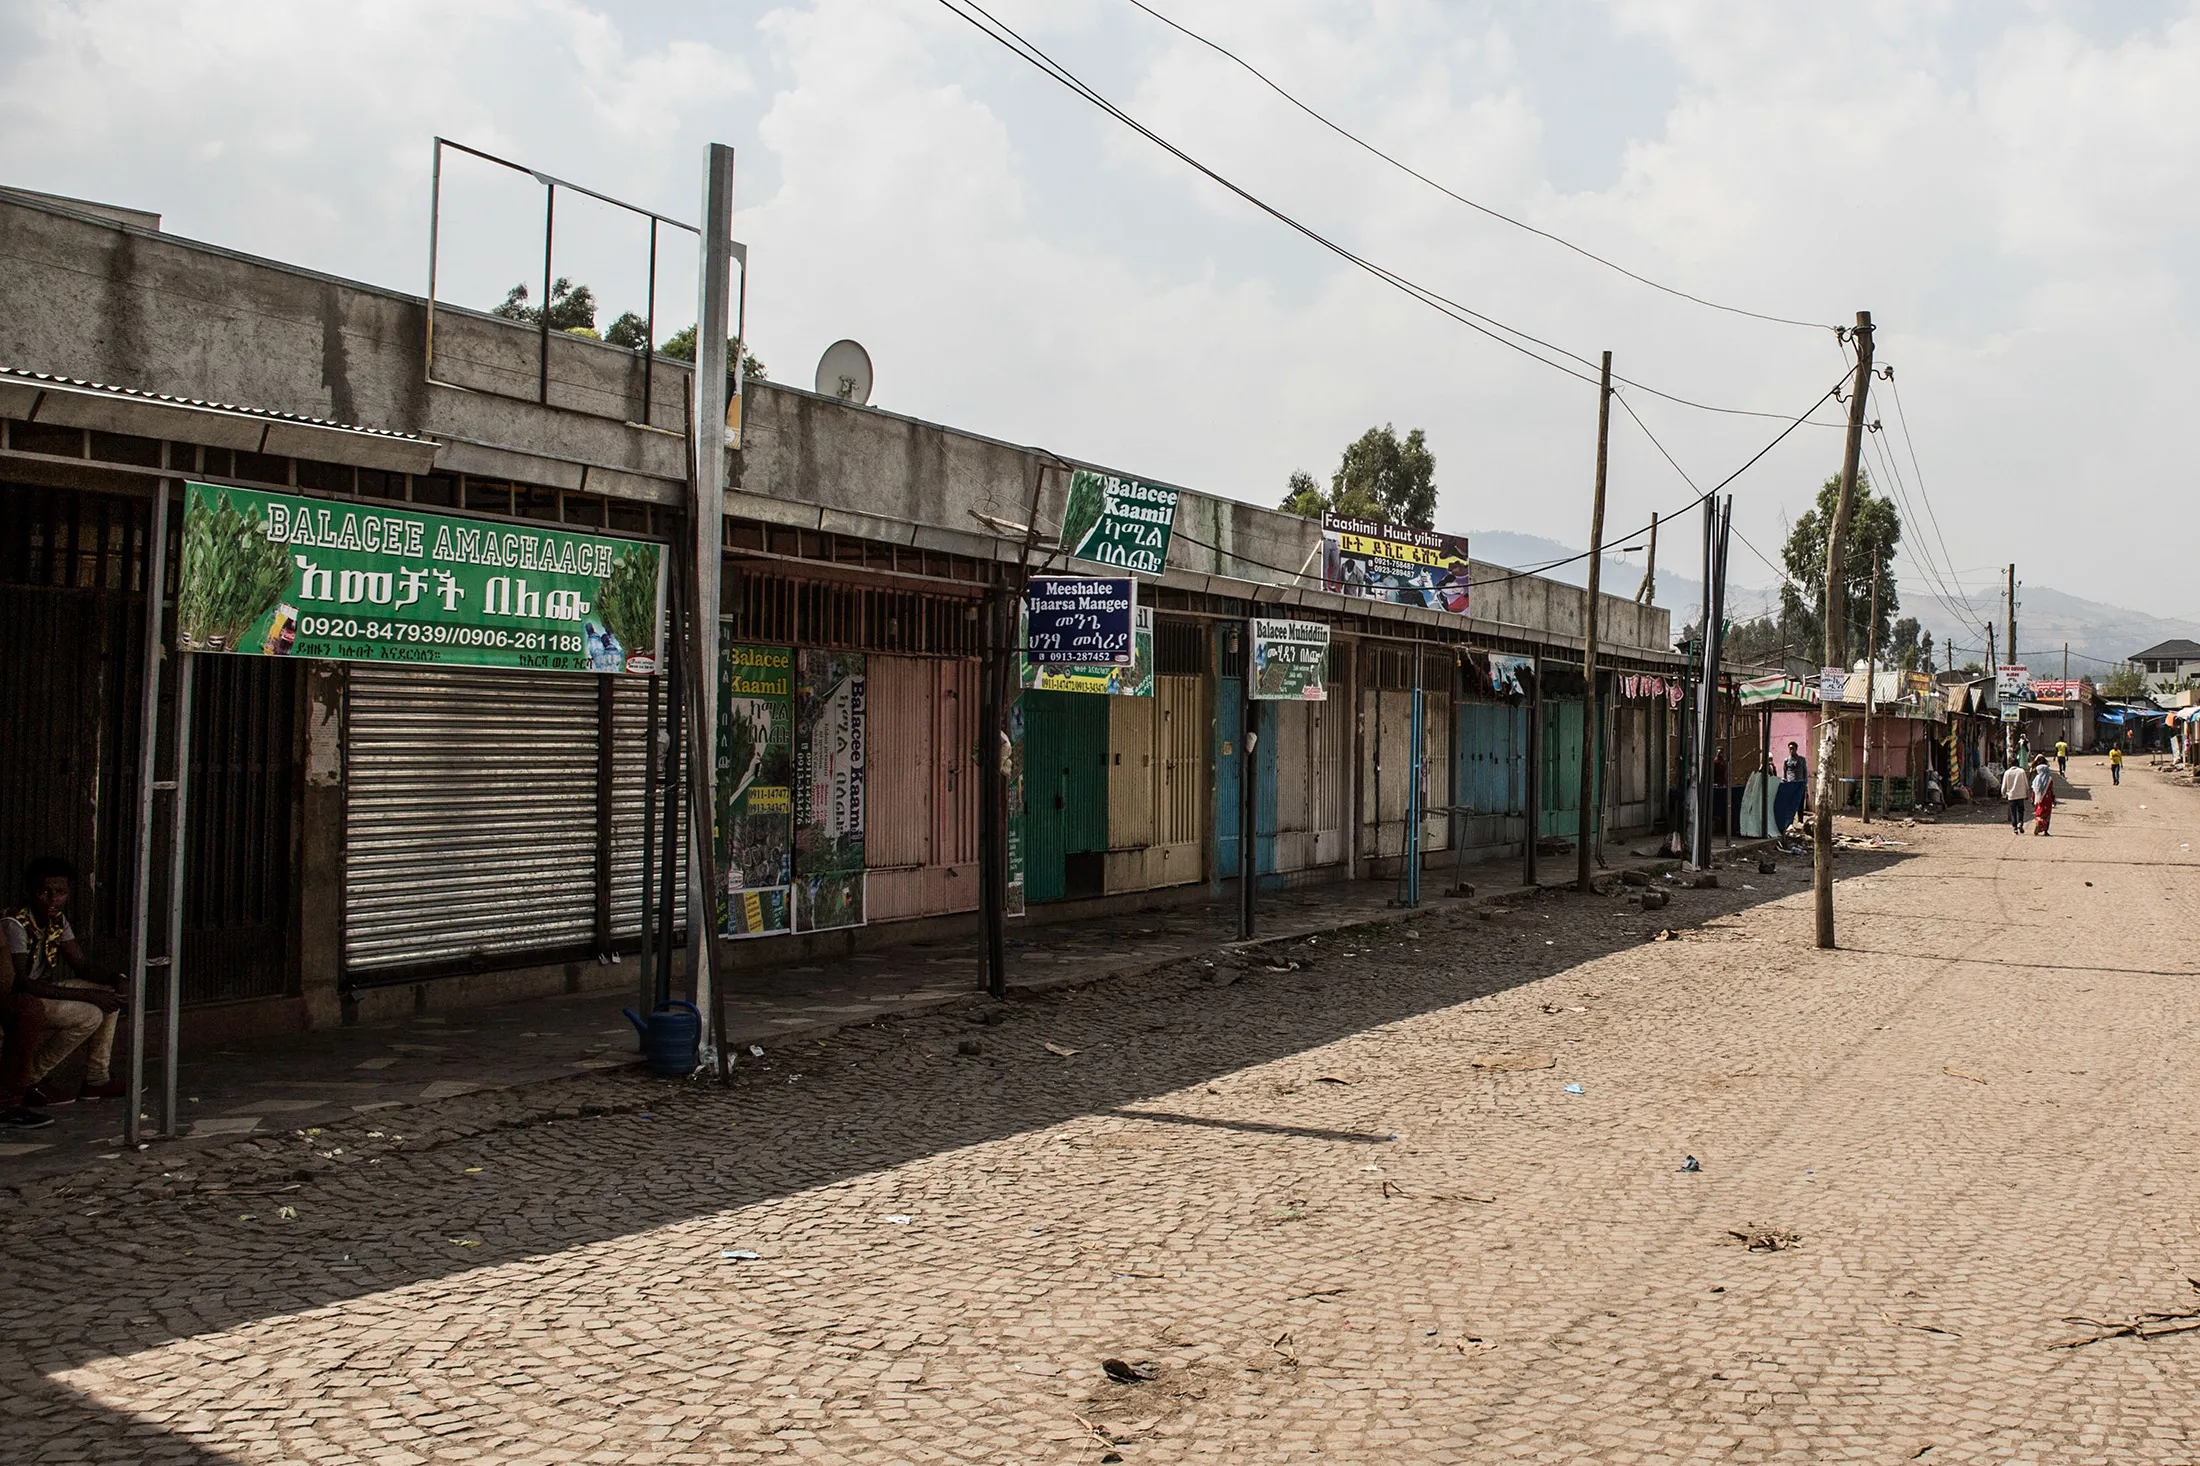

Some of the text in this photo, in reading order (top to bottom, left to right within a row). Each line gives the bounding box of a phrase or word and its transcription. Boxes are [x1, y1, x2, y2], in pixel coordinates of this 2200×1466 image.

[1106, 476, 1178, 506] Balacee
[1104, 496, 1173, 525] Kaamil
[266, 502, 613, 579] BALACEE AMACHAACH
[1105, 518, 1162, 548] ካሚል
[1325, 513, 1444, 547] Faashinii Huut yihiir
[295, 555, 465, 612] አመቻች
[1046, 582, 1113, 595] Meeshalee
[1030, 596, 1129, 614] Ijaarsa Mangee
[301, 616, 583, 652] 0920-847939//0906-261188
[1256, 620, 1328, 643] Balacee Muhiddiin
[731, 647, 789, 668] Balacee
[1050, 652, 1110, 661] 0913-287452
[731, 675, 788, 695] Kaamil
[850, 680, 865, 844] Balacee Kaamil
